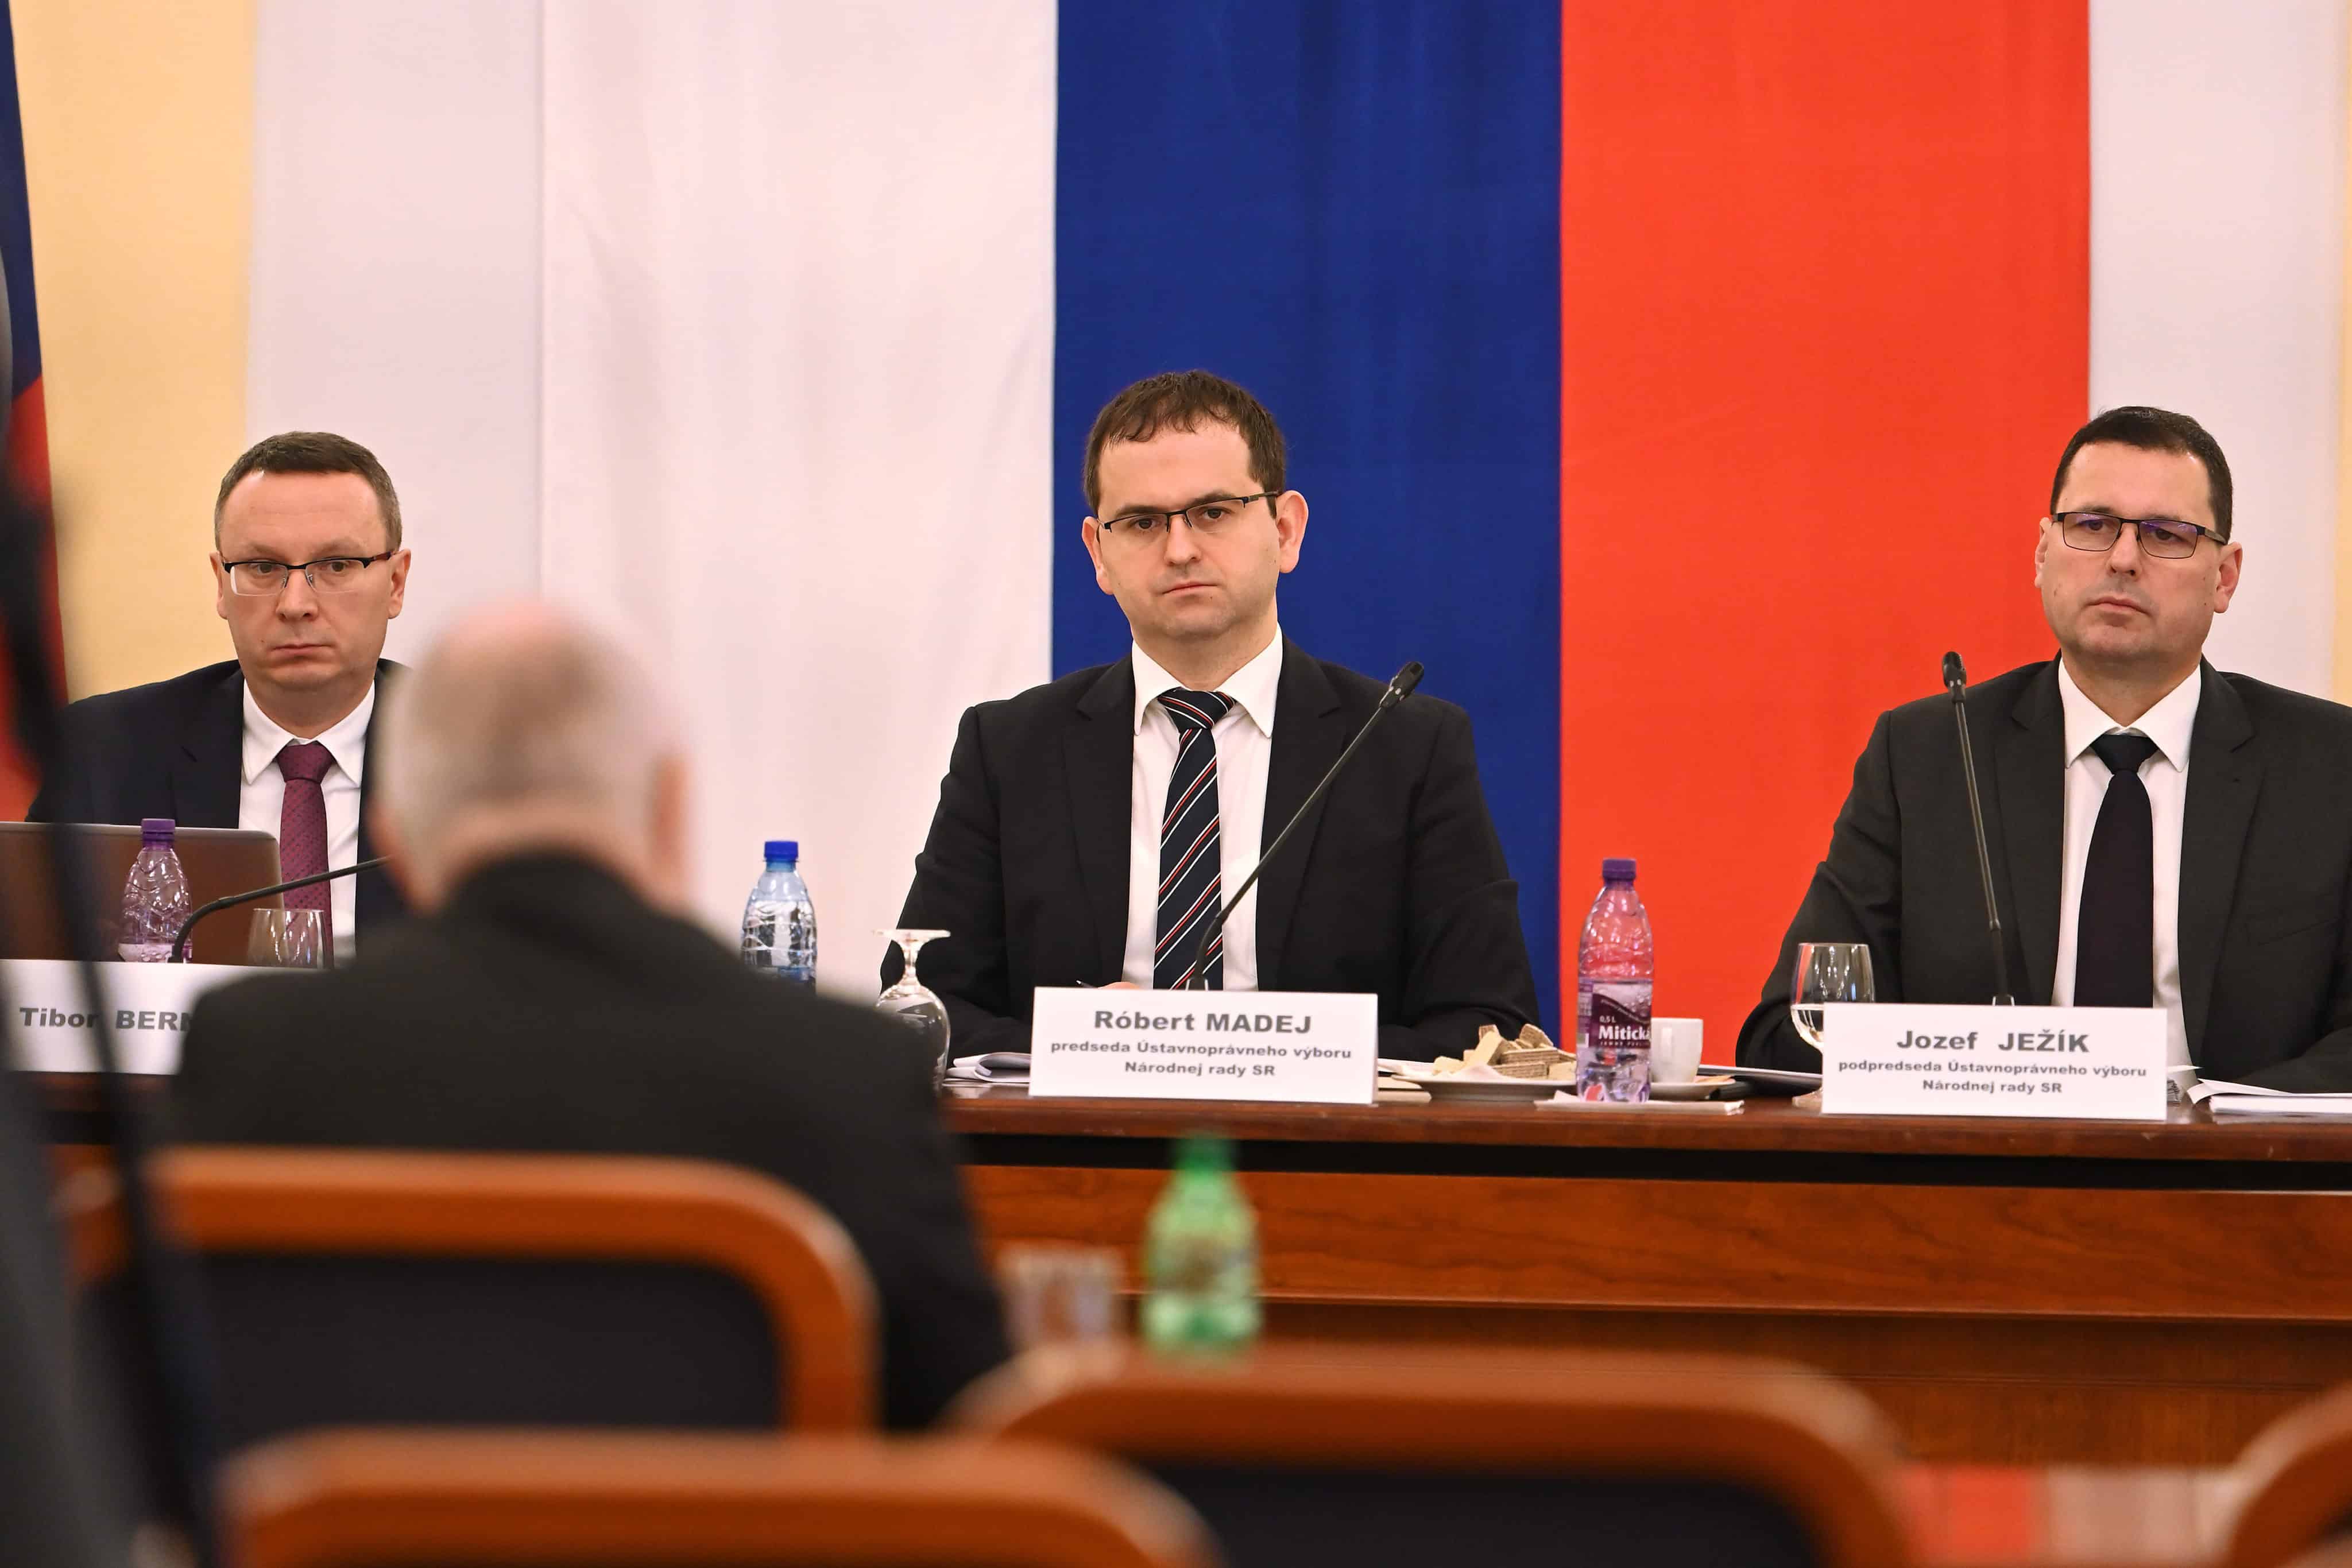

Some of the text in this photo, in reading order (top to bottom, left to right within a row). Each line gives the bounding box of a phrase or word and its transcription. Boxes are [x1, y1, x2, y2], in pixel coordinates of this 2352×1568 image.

[19, 1007, 99, 1028] Tibor
[1094, 1011, 1312, 1034] Róbert MADEJ
[1051, 1039, 1352, 1060] predseda Ústavnoprávneho výboru
[1897, 1028, 2090, 1053] Jozef JEŽÍK
[1125, 1062, 1275, 1078] Národnej rady SR
[1839, 1060, 2147, 1078] podpredseda Ústavnoprávneho výboru
[1922, 1079, 2063, 1095] Národnej rady SR
